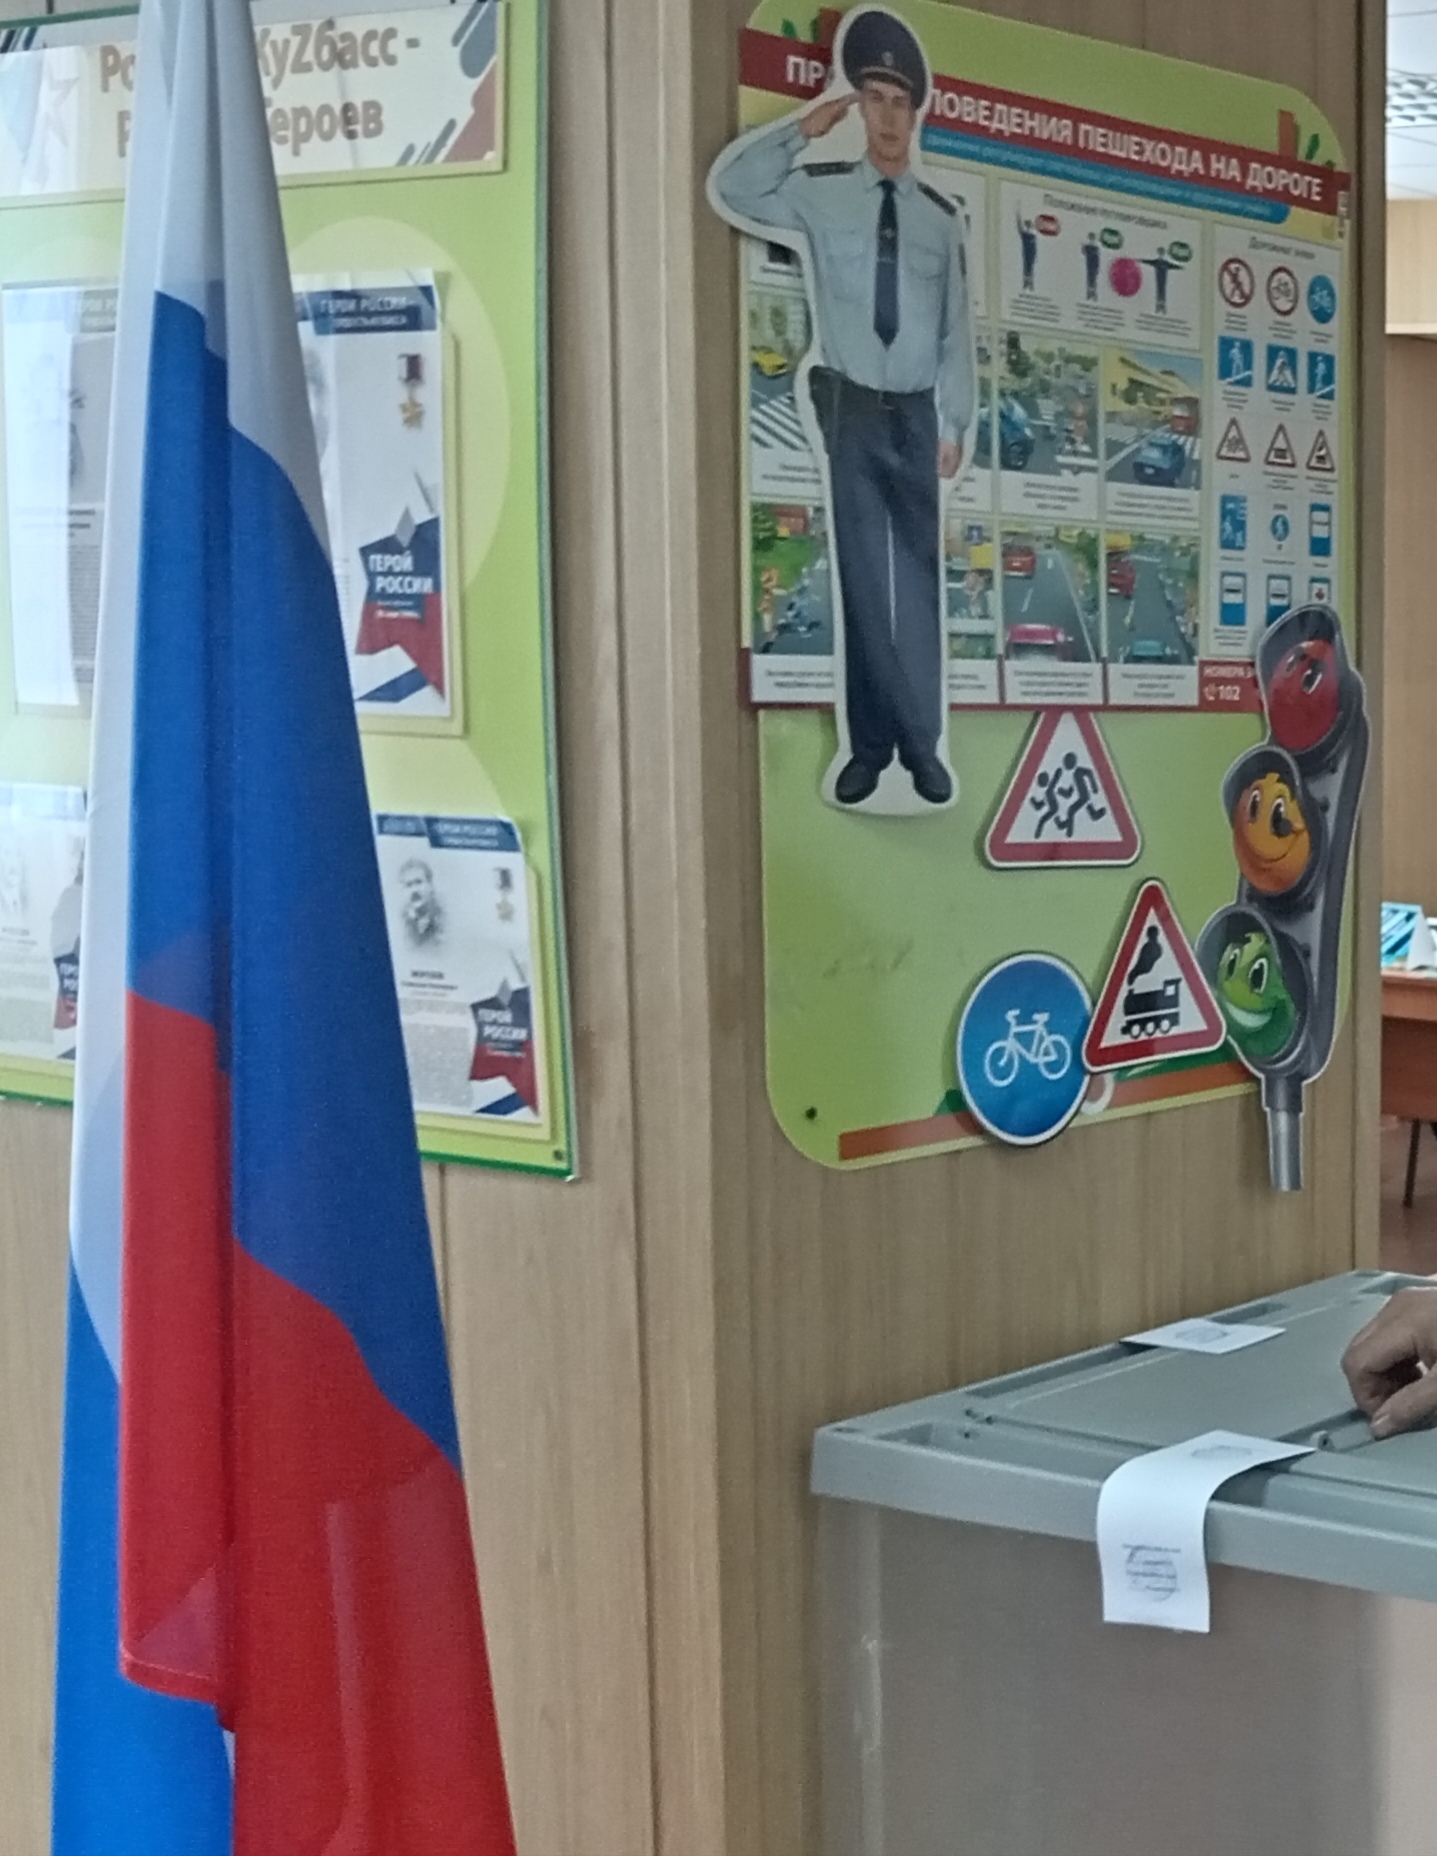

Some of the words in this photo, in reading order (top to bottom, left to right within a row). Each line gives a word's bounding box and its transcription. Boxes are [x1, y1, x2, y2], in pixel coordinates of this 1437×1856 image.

[263, 97, 384, 157] ероев
[932, 89, 1073, 146] ПОВЕДЕНИЯ
[1078, 122, 1205, 177] ПЕШЕХОДА
[1209, 153, 1241, 182] НА
[1245, 162, 1323, 201] ДОРОГЕ
[375, 576, 433, 594] РОССИИ
